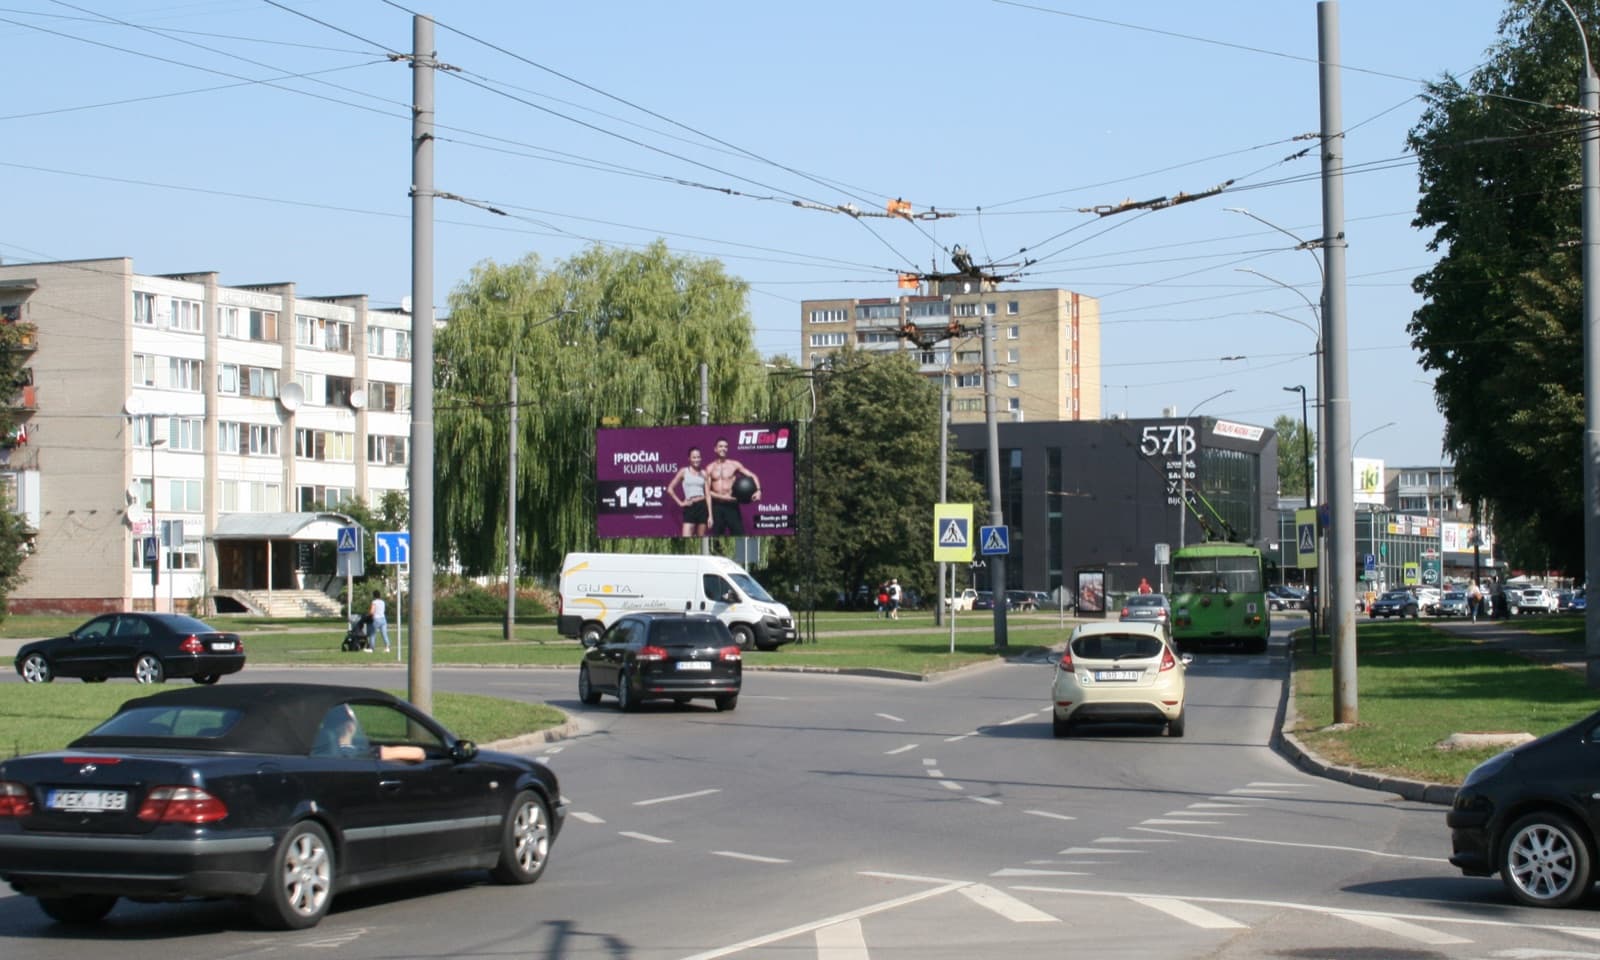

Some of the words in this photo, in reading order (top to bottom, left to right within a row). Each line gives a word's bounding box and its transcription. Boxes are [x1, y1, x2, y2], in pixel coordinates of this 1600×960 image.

[1140, 425, 1197, 456] 57B
[614, 450, 659, 466] ĮPROČIAI
[623, 464, 653, 474] KURIA
[656, 463, 678, 473] MUS
[1360, 466, 1379, 490] iki
[615, 486, 645, 508] 14
[758, 503, 788, 512] fitclub.lt
